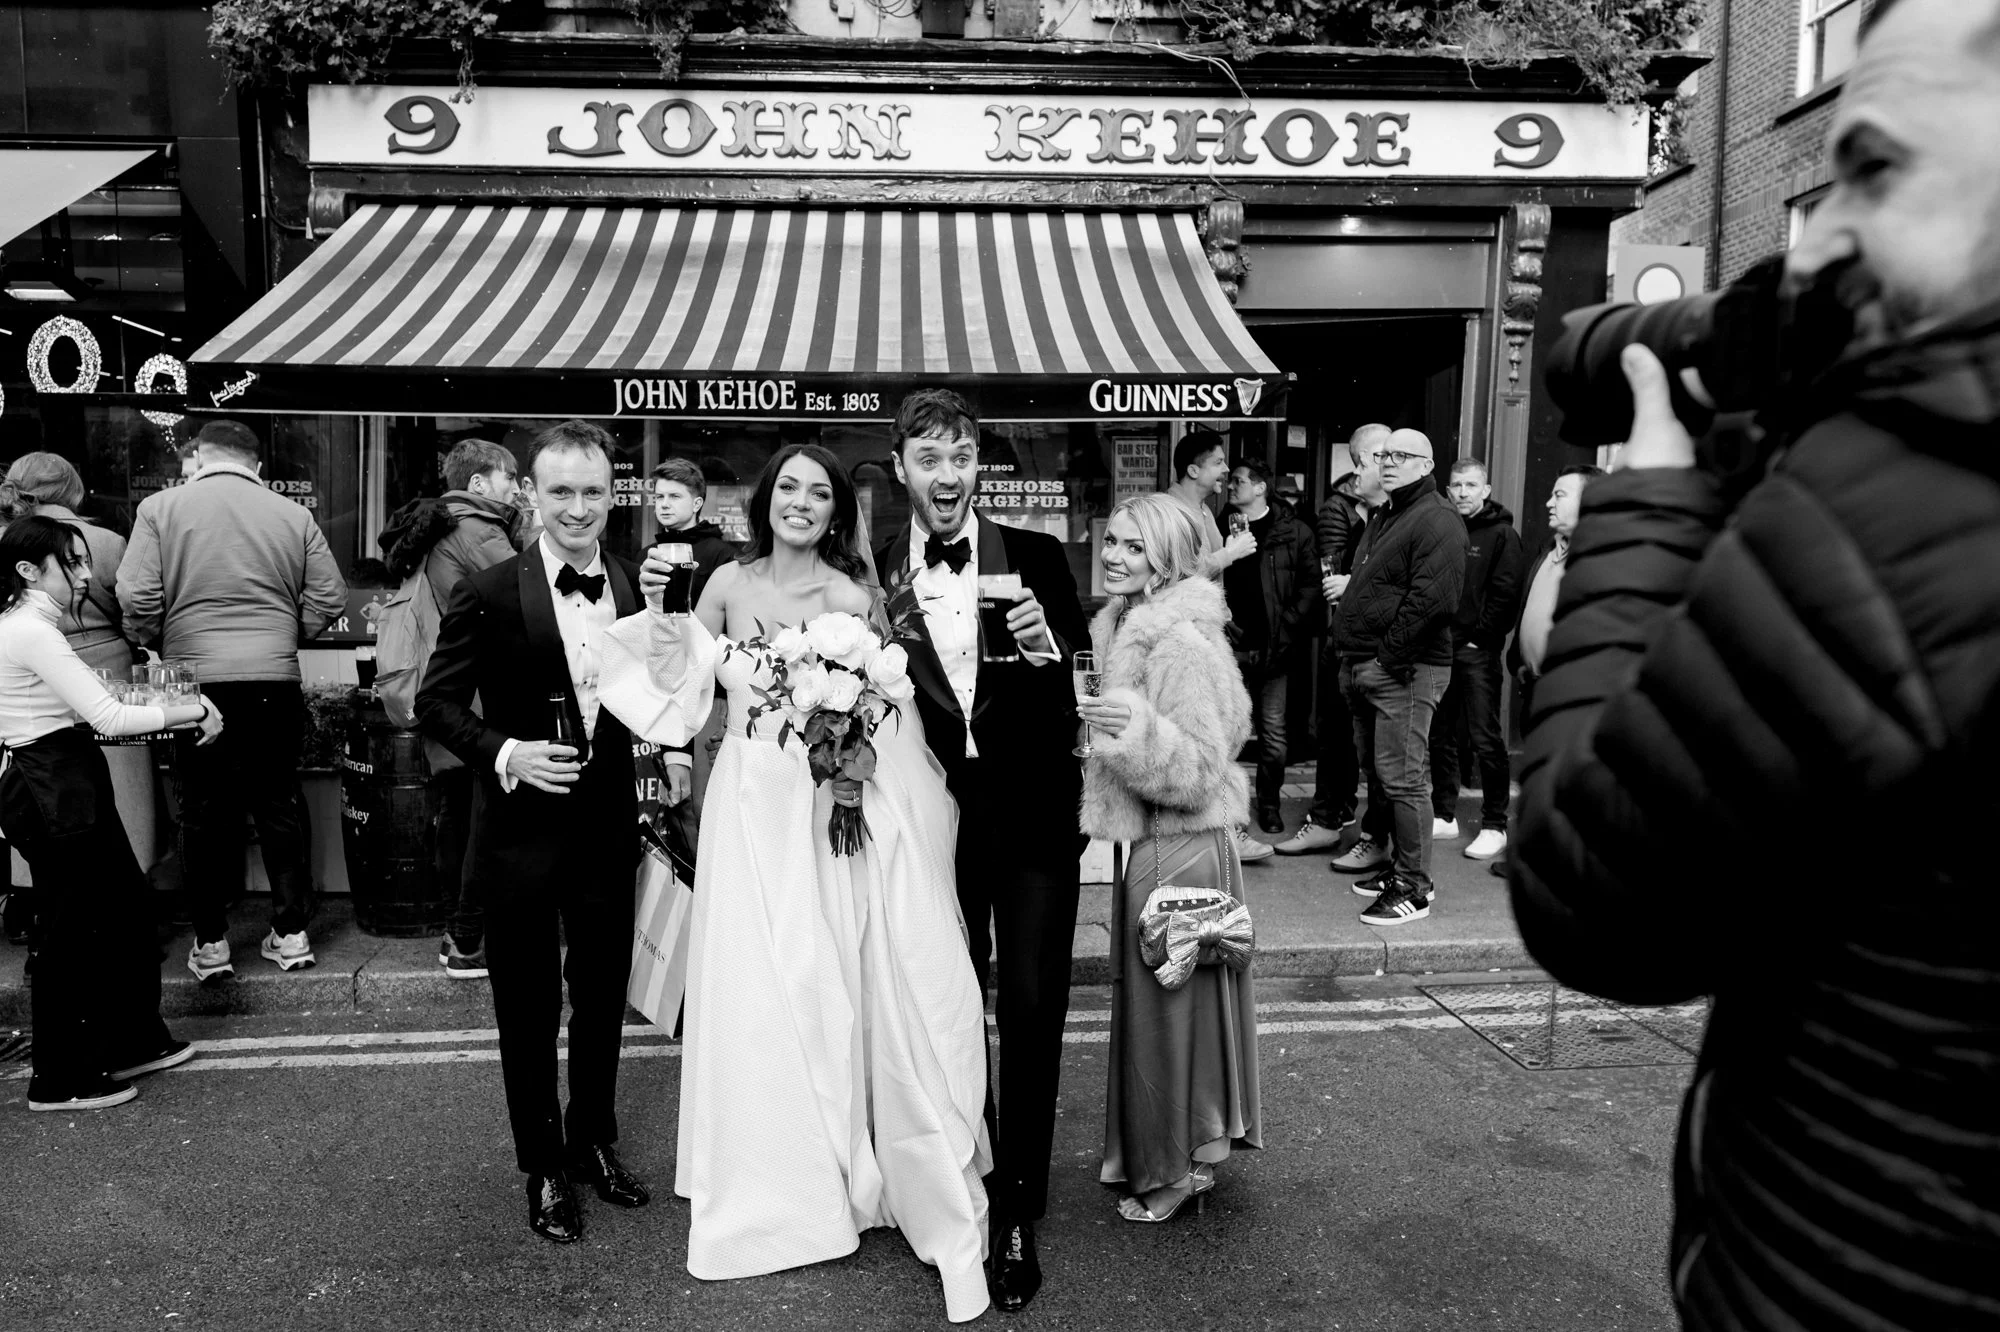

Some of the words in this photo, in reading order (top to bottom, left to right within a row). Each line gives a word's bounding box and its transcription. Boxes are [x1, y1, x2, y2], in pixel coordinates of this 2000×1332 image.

[384, 95, 461, 156] 9
[547, 98, 912, 161] JOHN
[984, 104, 1411, 166] KEHOE
[1494, 112, 1565, 170] 9
[613, 378, 688, 417] JOHN
[697, 379, 797, 411] KEHOE
[804, 392, 837, 411] Est.
[842, 393, 880, 412] 1803
[1089, 379, 1228, 412] GUINNESS
[1117, 444, 1133, 455] BAR
[1121, 456, 1155, 468] WANTED
[980, 481, 1064, 493] KEHOES
[1025, 496, 1069, 508] PUB
[156, 732, 174, 740] BAR
